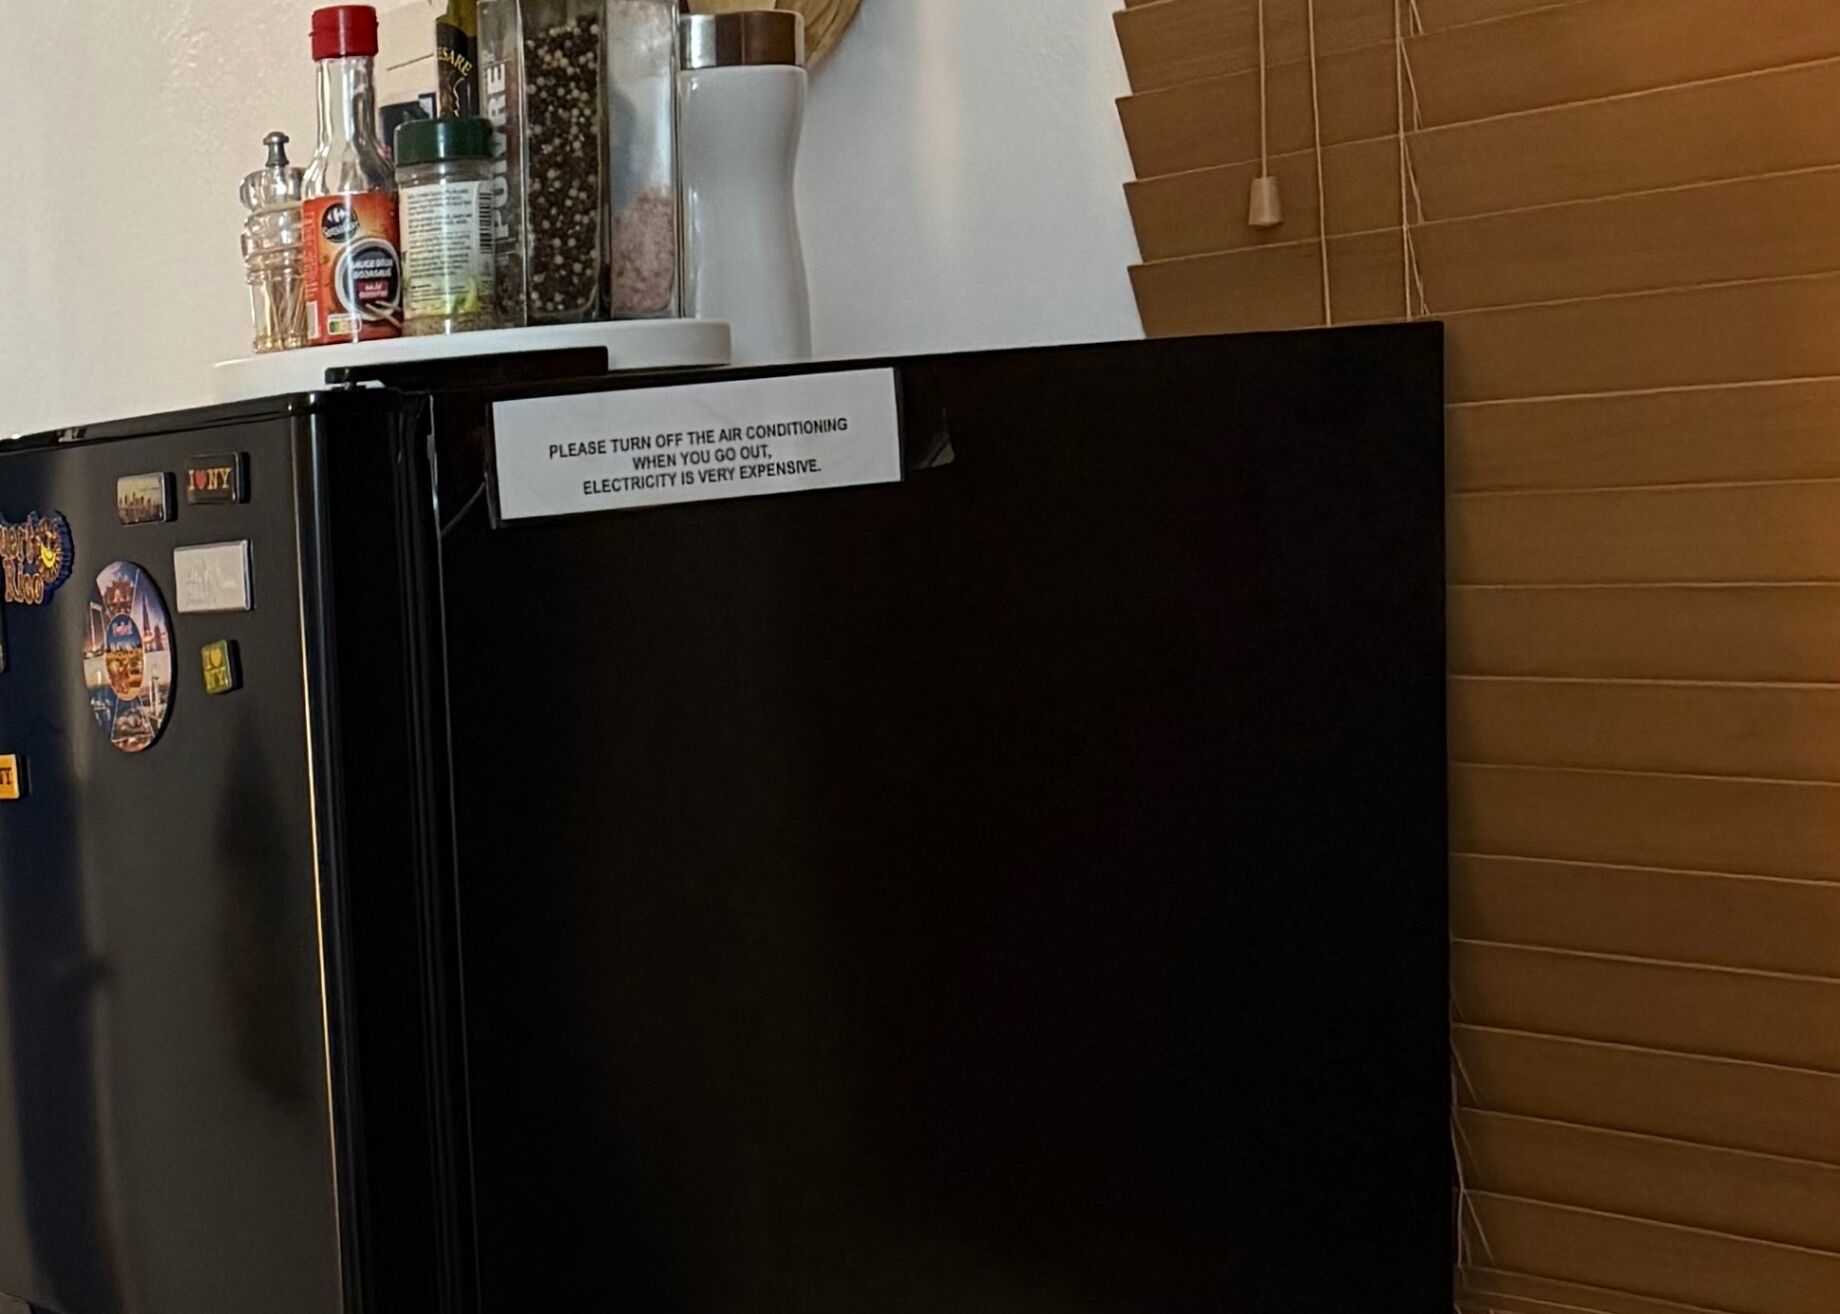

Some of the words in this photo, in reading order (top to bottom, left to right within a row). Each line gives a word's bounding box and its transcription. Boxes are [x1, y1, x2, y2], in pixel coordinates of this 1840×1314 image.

[549, 440, 607, 459] PLEASE
[610, 436, 651, 452] TURN
[655, 433, 683, 448] OFF
[687, 430, 715, 445] THE
[718, 427, 742, 442] AIR
[746, 418, 848, 440] CONDITIONING
[632, 454, 676, 470] WHEN
[680, 450, 710, 465] YOU
[714, 447, 736, 462] GO
[740, 444, 772, 459] OUT,
[206, 467, 233, 490] NY
[583, 472, 677, 495] ELECTRICITY
[681, 470, 695, 486] IS
[698, 467, 735, 483] VERY
[739, 459, 822, 479] EXPENSIVE.
